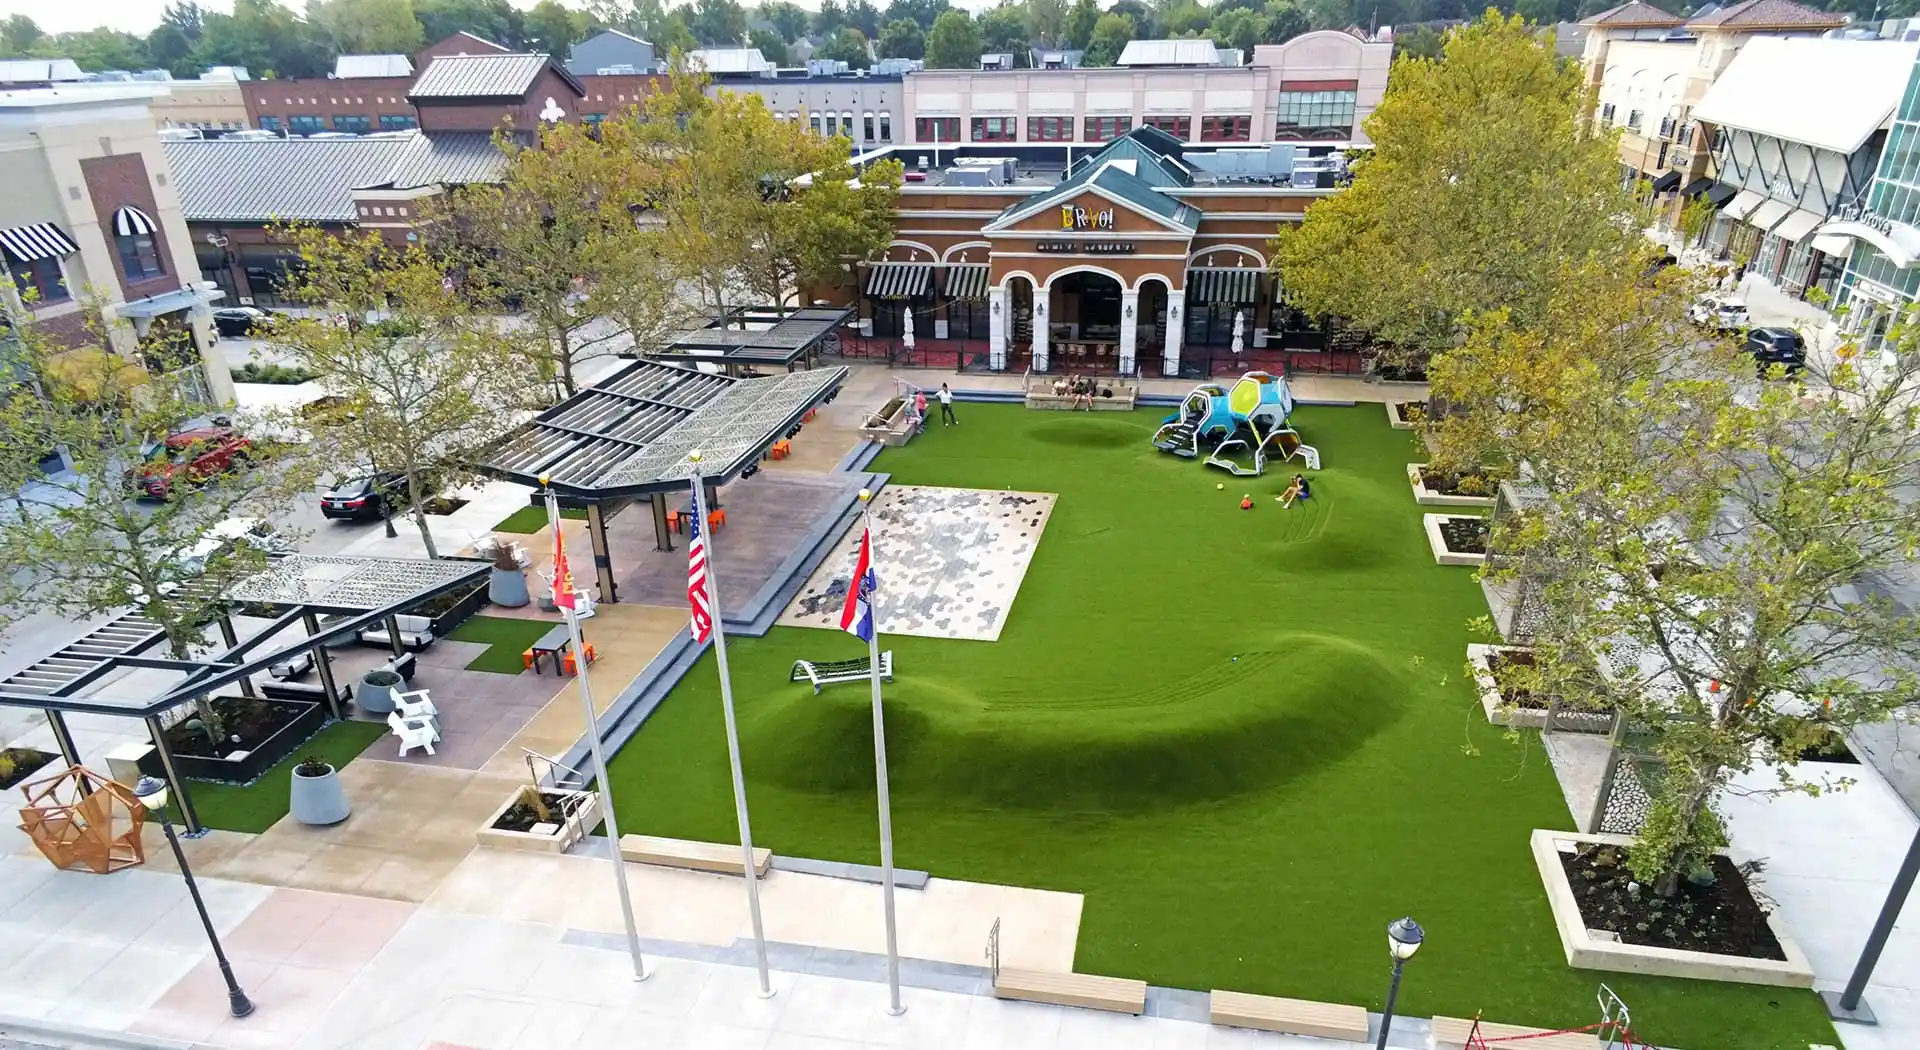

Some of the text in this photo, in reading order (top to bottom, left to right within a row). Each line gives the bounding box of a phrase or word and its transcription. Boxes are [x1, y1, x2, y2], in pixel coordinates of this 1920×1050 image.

[1062, 206, 1114, 230] BRAVO!
[1838, 203, 1892, 237] The Grove
